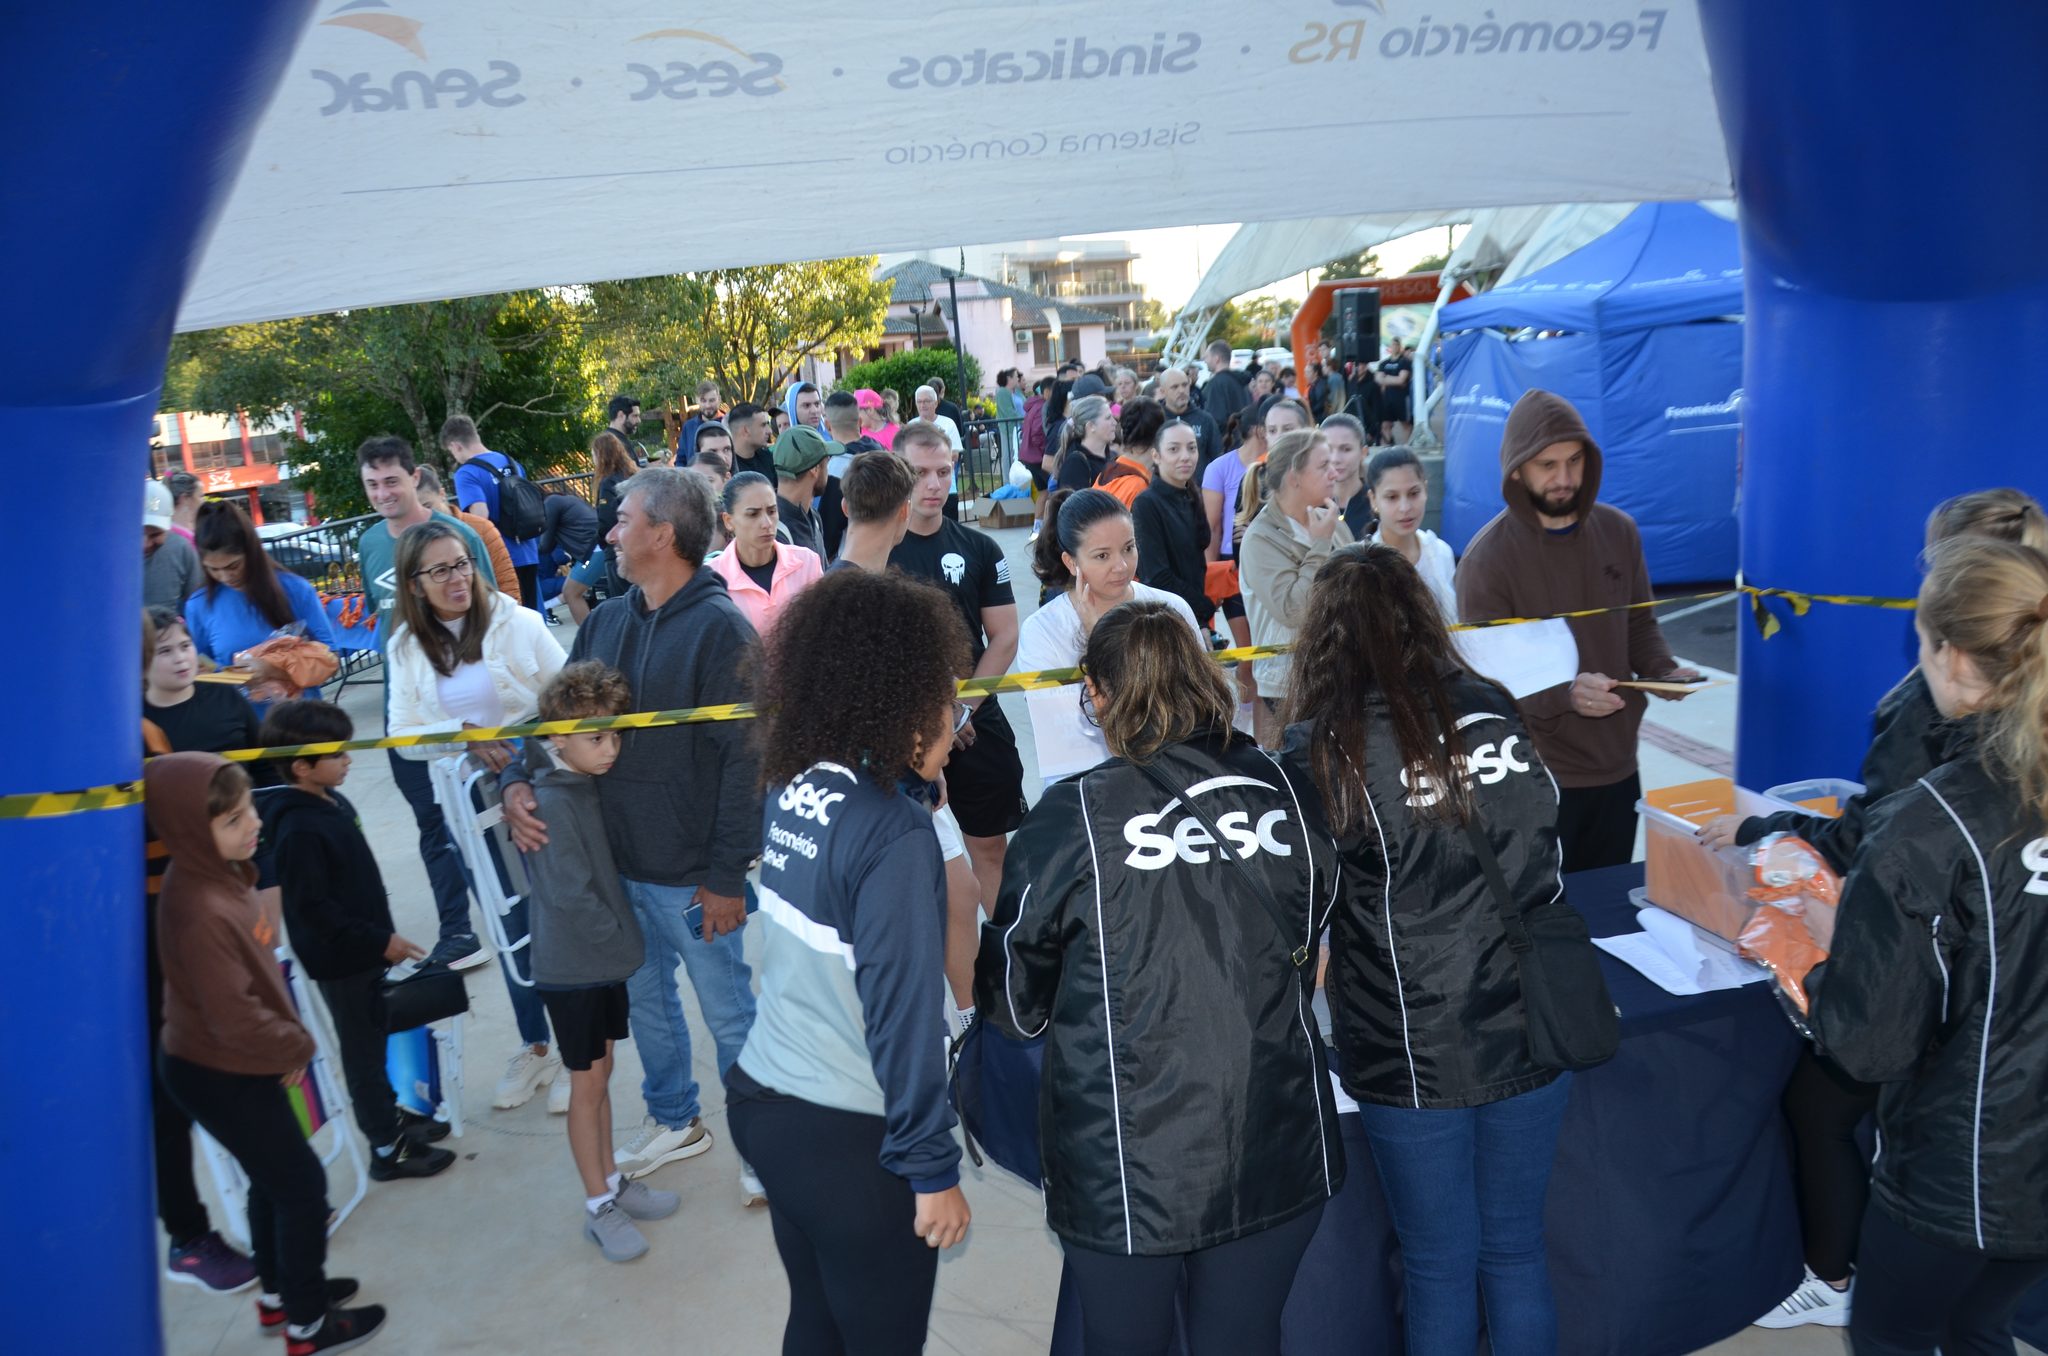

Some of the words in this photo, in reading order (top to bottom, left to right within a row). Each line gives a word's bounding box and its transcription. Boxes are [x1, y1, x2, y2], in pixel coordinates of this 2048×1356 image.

[1381, 279, 1435, 298] RESOL
[778, 780, 846, 826] Sesc
[1123, 808, 1292, 871] Sesc
